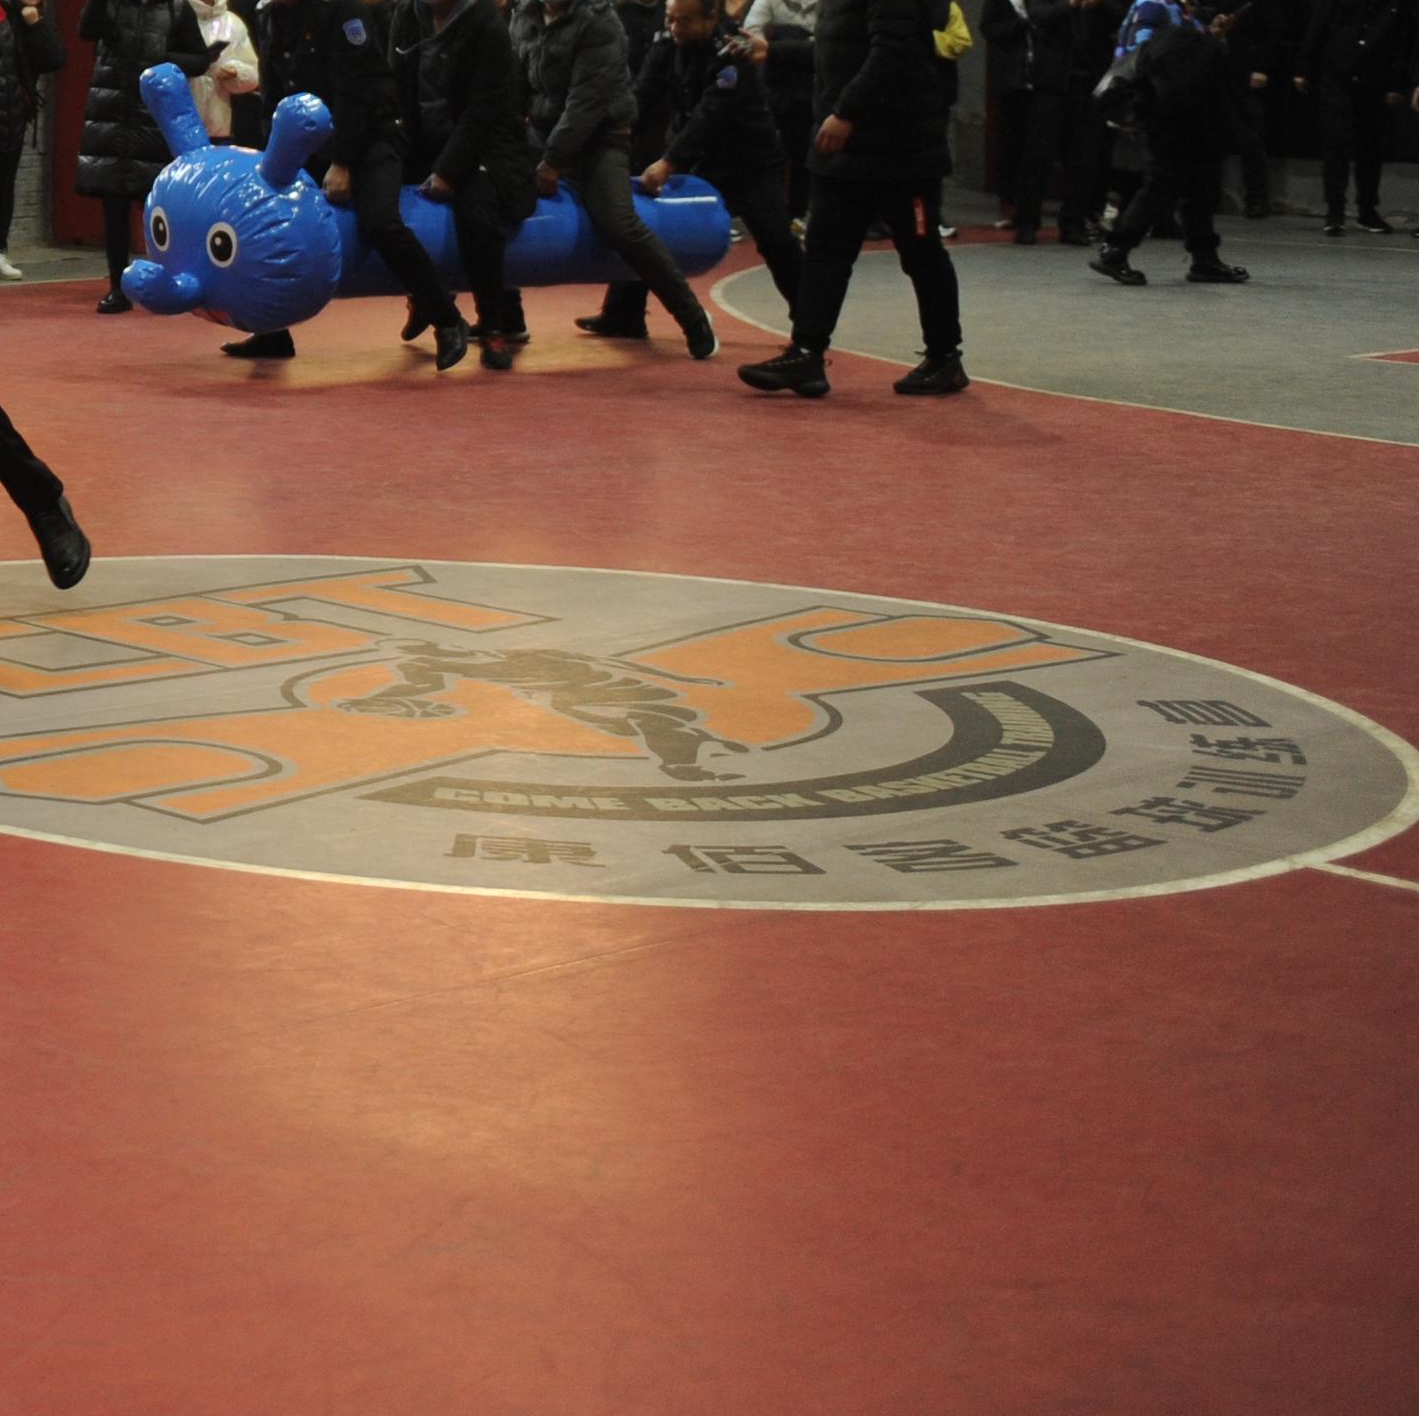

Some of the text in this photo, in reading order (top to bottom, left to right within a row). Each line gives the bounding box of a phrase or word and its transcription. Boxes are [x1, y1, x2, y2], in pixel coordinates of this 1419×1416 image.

[434, 690, 1057, 812] COME BACK BASKETBALL TRAINING
[447, 698, 1309, 875] 康佰客篮球训练营
